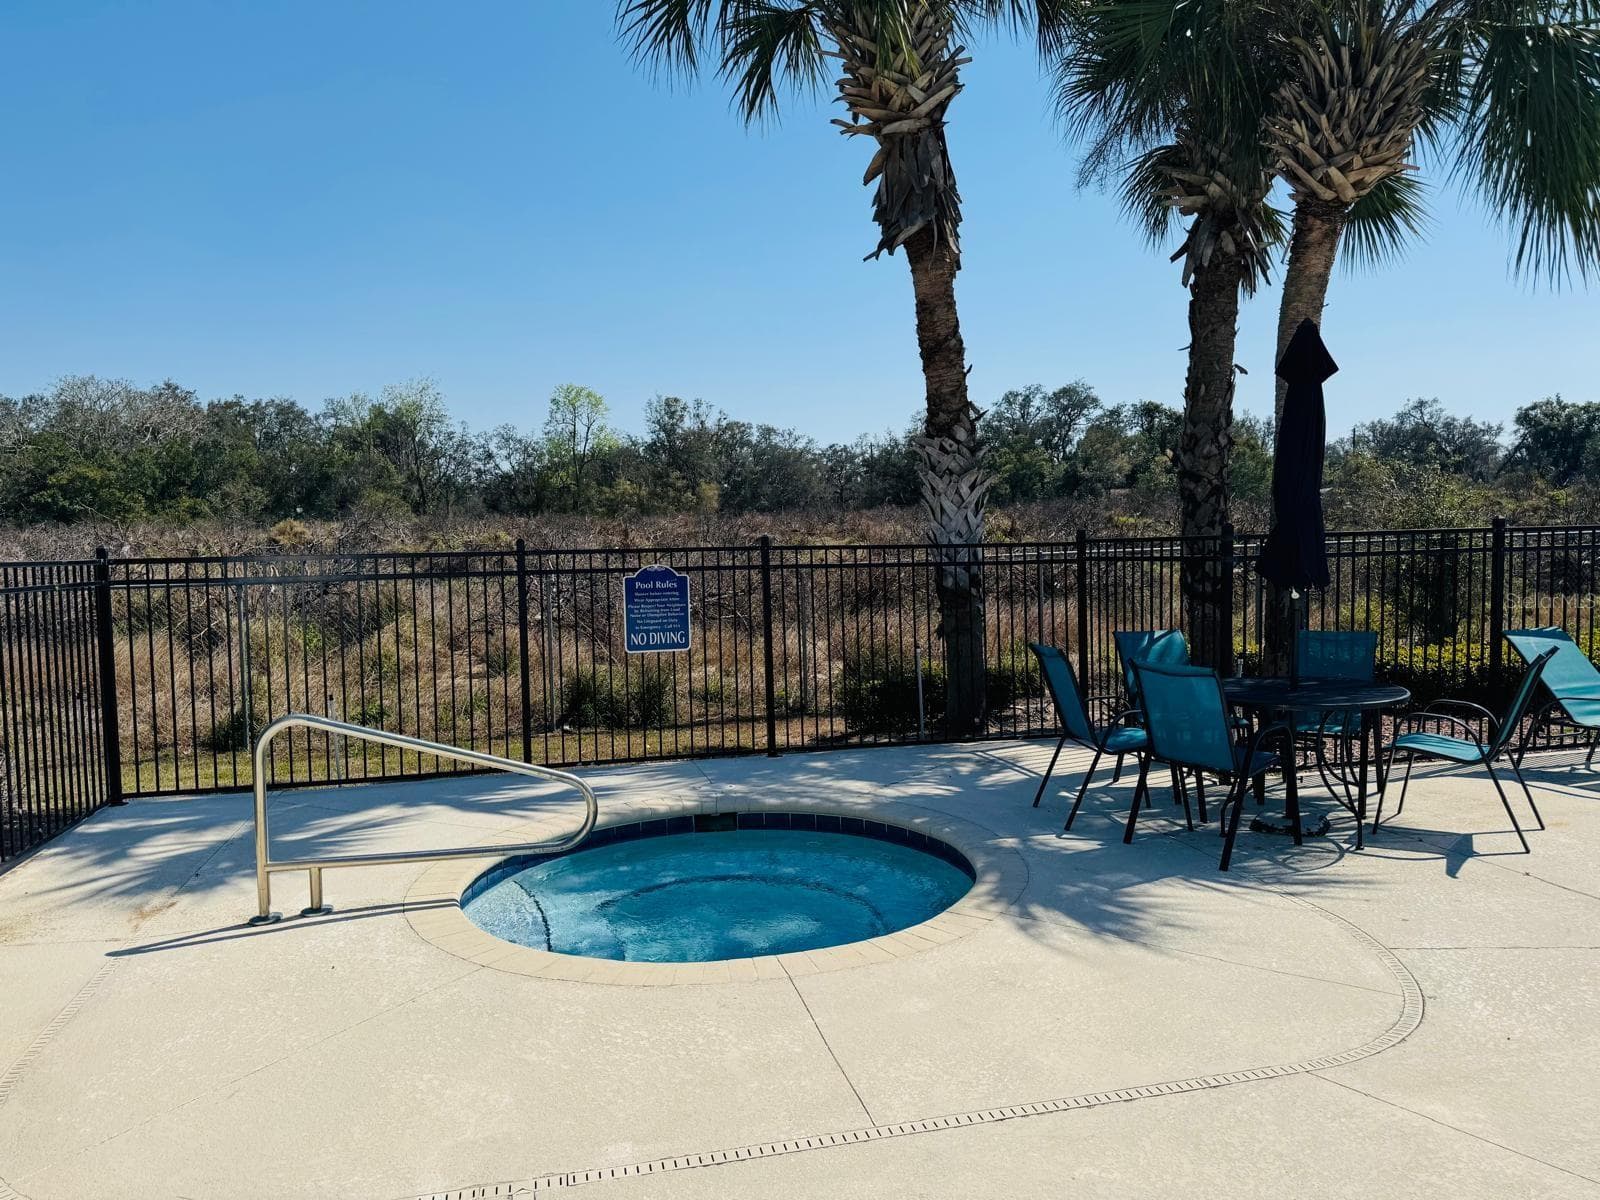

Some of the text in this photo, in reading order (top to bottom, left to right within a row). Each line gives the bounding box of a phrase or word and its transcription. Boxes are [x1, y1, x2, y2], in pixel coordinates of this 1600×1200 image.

[635, 580, 678, 589] Pool Rules
[631, 630, 685, 646] NO DIVING
